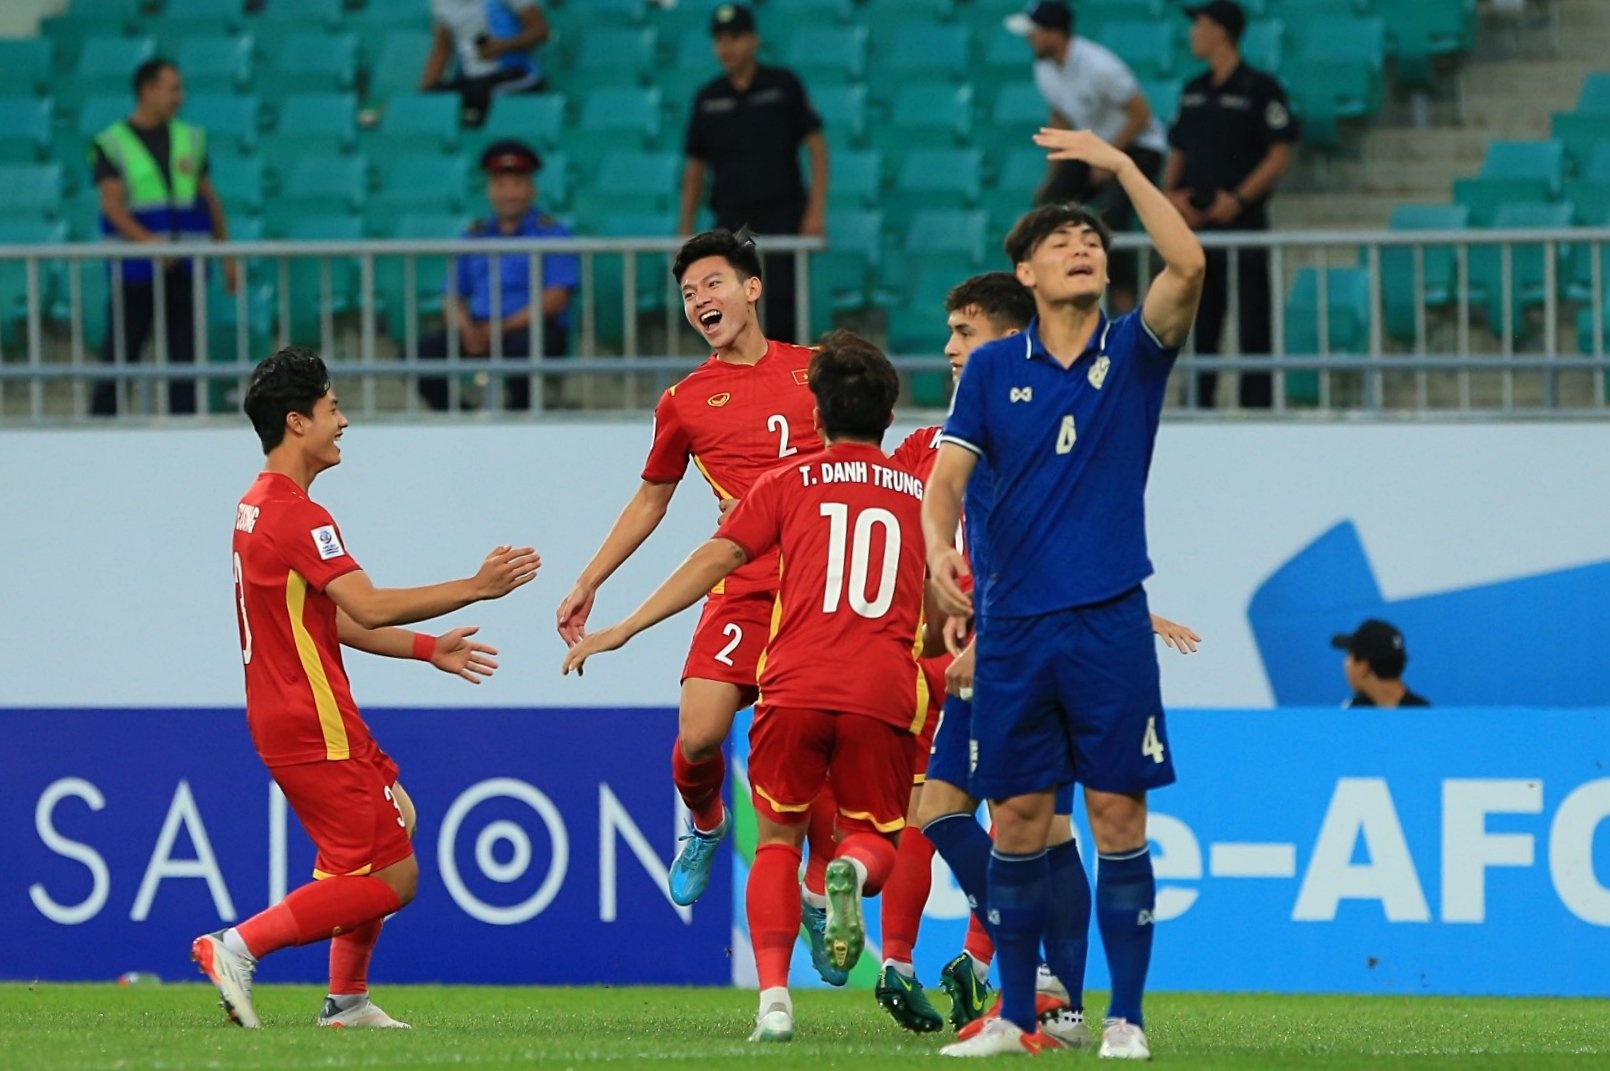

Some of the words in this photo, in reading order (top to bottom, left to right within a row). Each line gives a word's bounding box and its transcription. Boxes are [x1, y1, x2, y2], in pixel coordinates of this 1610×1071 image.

[767, 414, 798, 458] 2
[799, 465, 817, 487] T.
[821, 461, 868, 484] DANH
[871, 463, 924, 501] TRUNG
[819, 502, 902, 619] 10
[714, 622, 743, 667] 2
[1141, 715, 1165, 764] 4
[384, 785, 406, 828] 3
[29, 776, 692, 925] SAION
